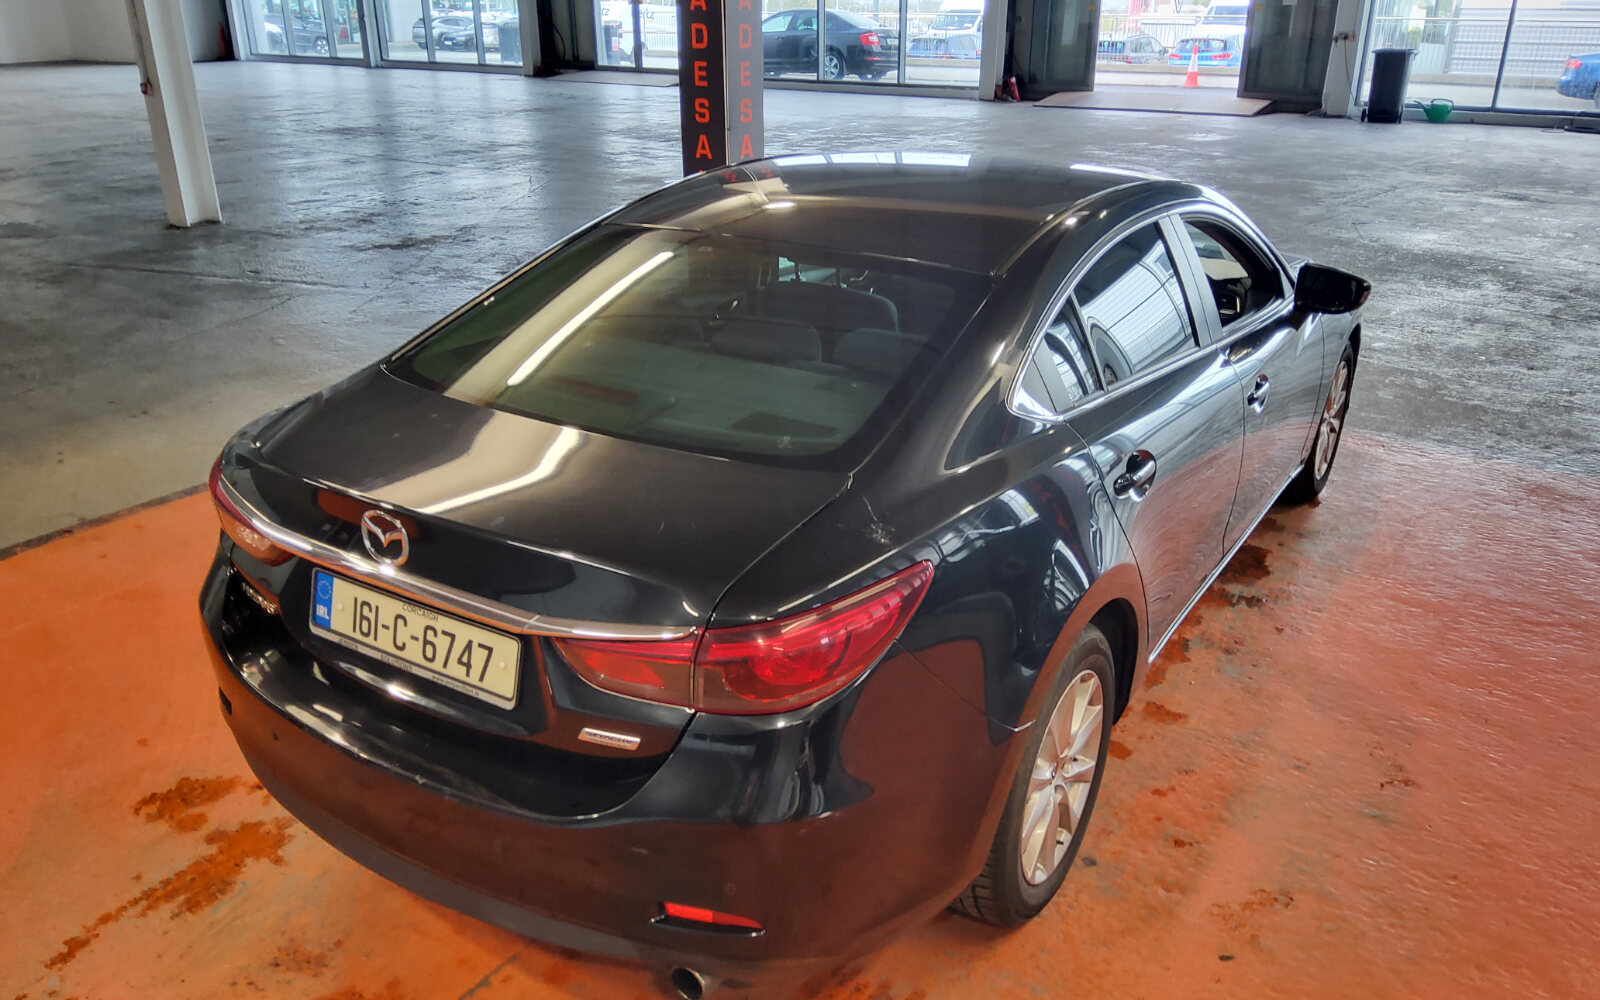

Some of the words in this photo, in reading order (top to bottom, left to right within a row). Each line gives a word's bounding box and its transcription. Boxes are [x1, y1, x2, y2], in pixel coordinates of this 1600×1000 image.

[316, 603, 330, 620] IRL
[401, 603, 439, 622] CORCAIGH
[352, 596, 494, 683] 161-C-6747
